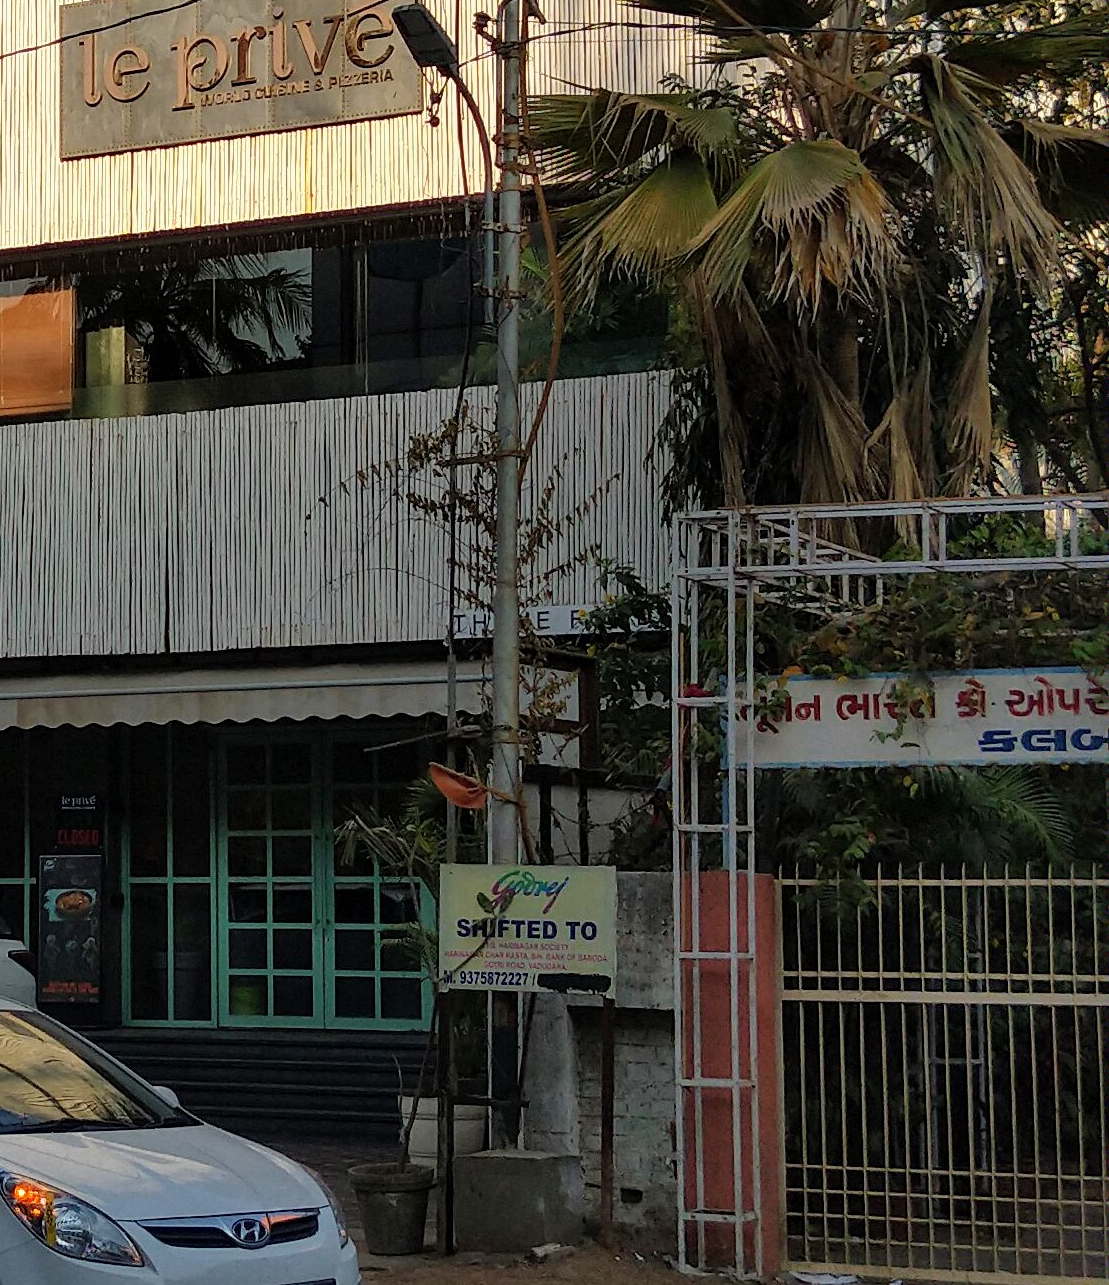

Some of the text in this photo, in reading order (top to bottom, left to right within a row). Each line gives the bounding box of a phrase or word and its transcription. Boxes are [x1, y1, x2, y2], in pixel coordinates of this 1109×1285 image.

[78, 33, 151, 107] le
[199, 69, 395, 107] WORLD CUISINE & PIZZERIA
[491, 870, 569, 914] Godrej
[457, 919, 597, 940] SHIFTED TO
[459, 971, 529, 985] 9375872227
